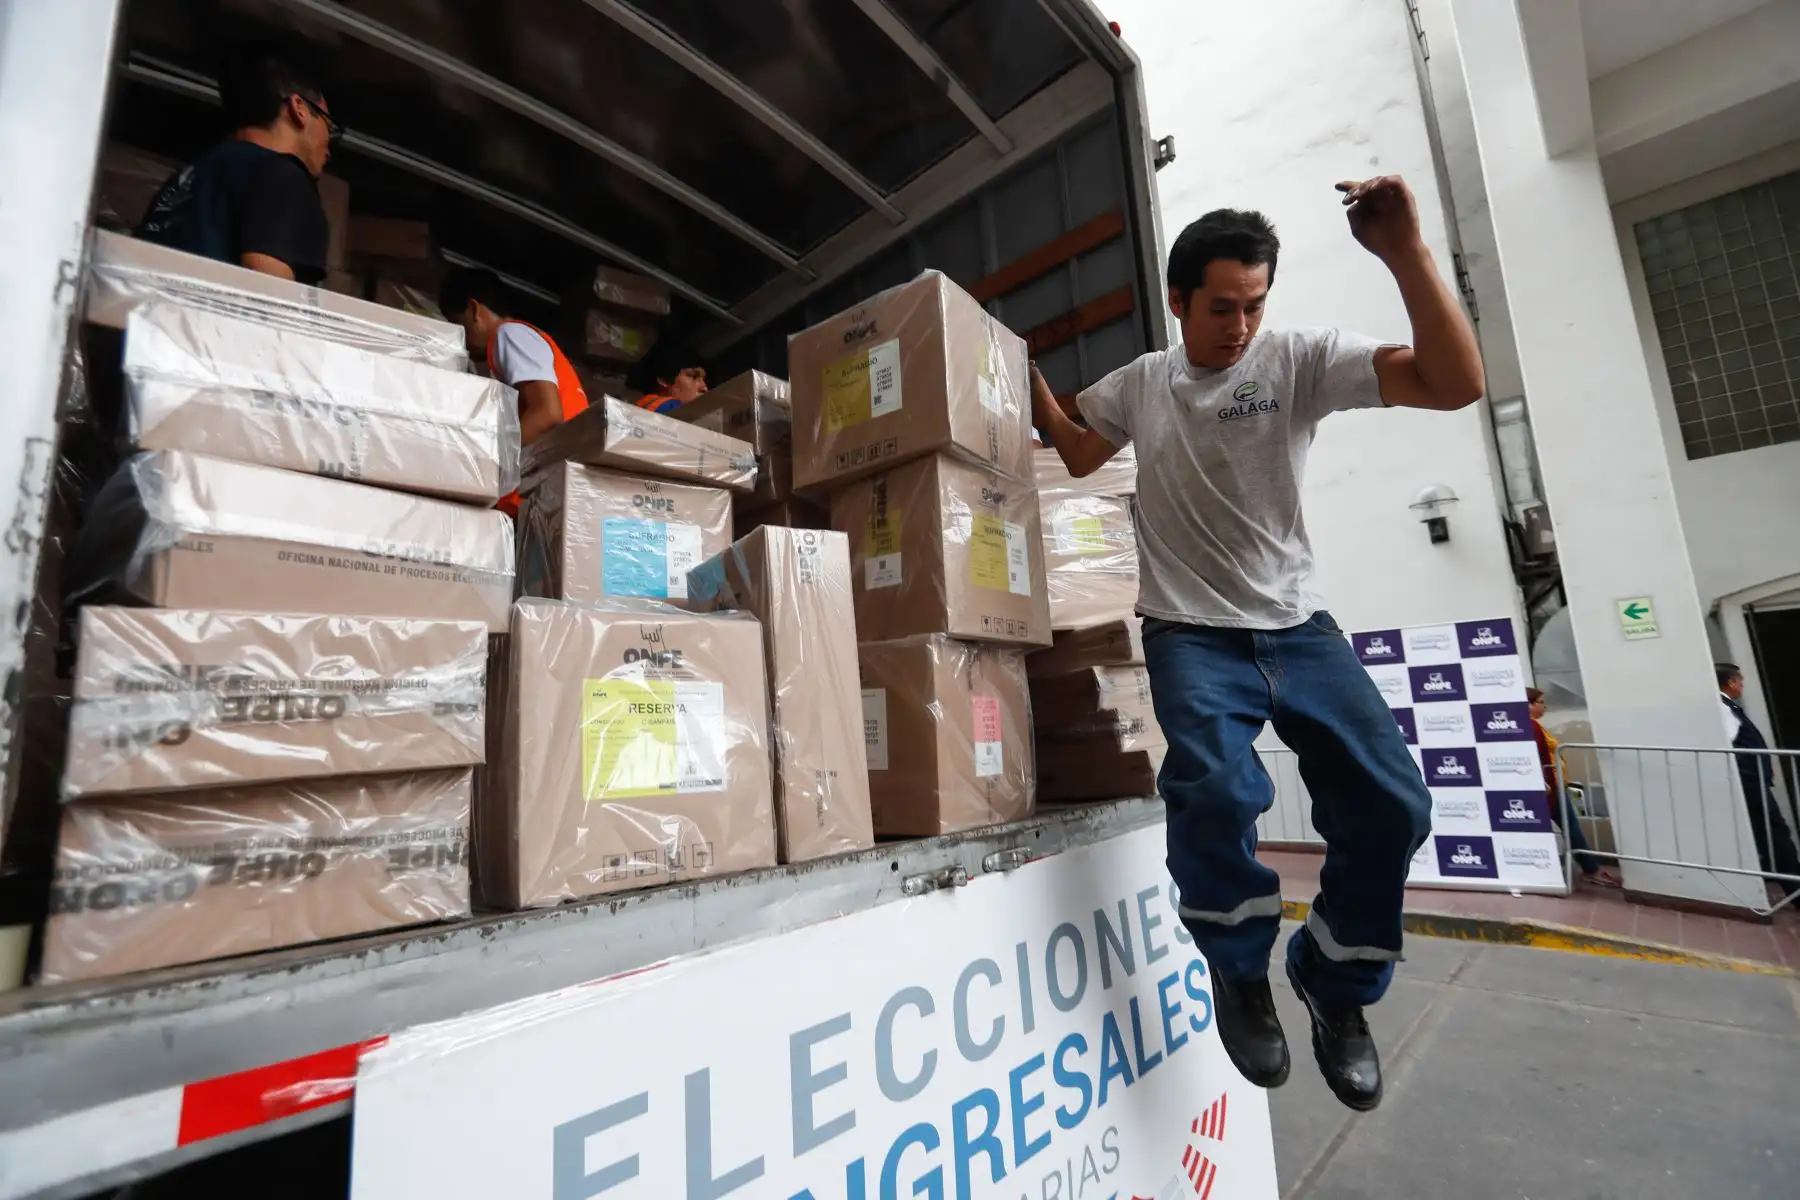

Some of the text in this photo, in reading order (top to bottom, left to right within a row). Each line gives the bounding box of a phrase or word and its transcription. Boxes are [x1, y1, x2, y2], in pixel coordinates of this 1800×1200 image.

[1218, 399, 1279, 420] GALAGA
[632, 494, 675, 512] ONPE
[277, 550, 325, 567] OFICINA
[328, 557, 381, 573] NACIONAL
[384, 564, 398, 576] DE
[400, 567, 450, 582] PROCESOS
[1471, 635, 1502, 647] ONPE
[1365, 645, 1392, 655] ONPE
[623, 648, 683, 669] ONPE
[1423, 681, 1452, 692] ONPE
[218, 694, 347, 723] ONPE
[628, 703, 687, 715] RESERVA
[1487, 720, 1518, 731] ONPE
[1436, 765, 1467, 776] ONPE
[1503, 809, 1535, 820] ONPE
[1451, 855, 1482, 866] ONPE
[1019, 1126, 1121, 1200] RIAS
